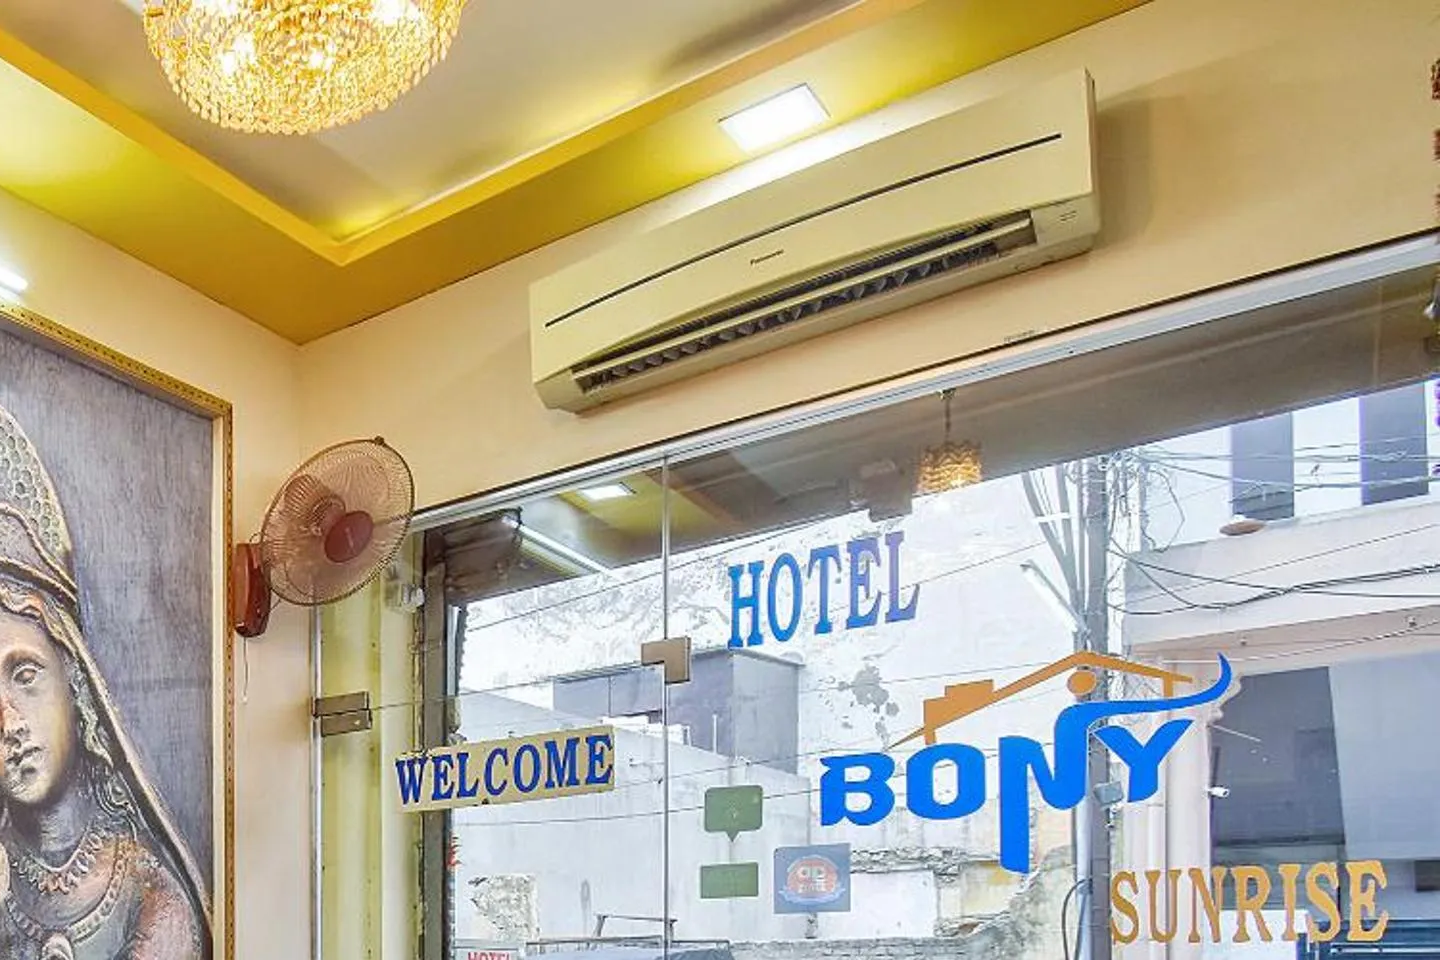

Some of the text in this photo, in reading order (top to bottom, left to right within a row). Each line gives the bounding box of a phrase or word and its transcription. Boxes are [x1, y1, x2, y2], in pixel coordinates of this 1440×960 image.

[728, 531, 920, 650] HOTEL
[394, 729, 614, 804] WELCOME
[821, 652, 1233, 873] BONY
[1110, 860, 1389, 945] SUNRISE
